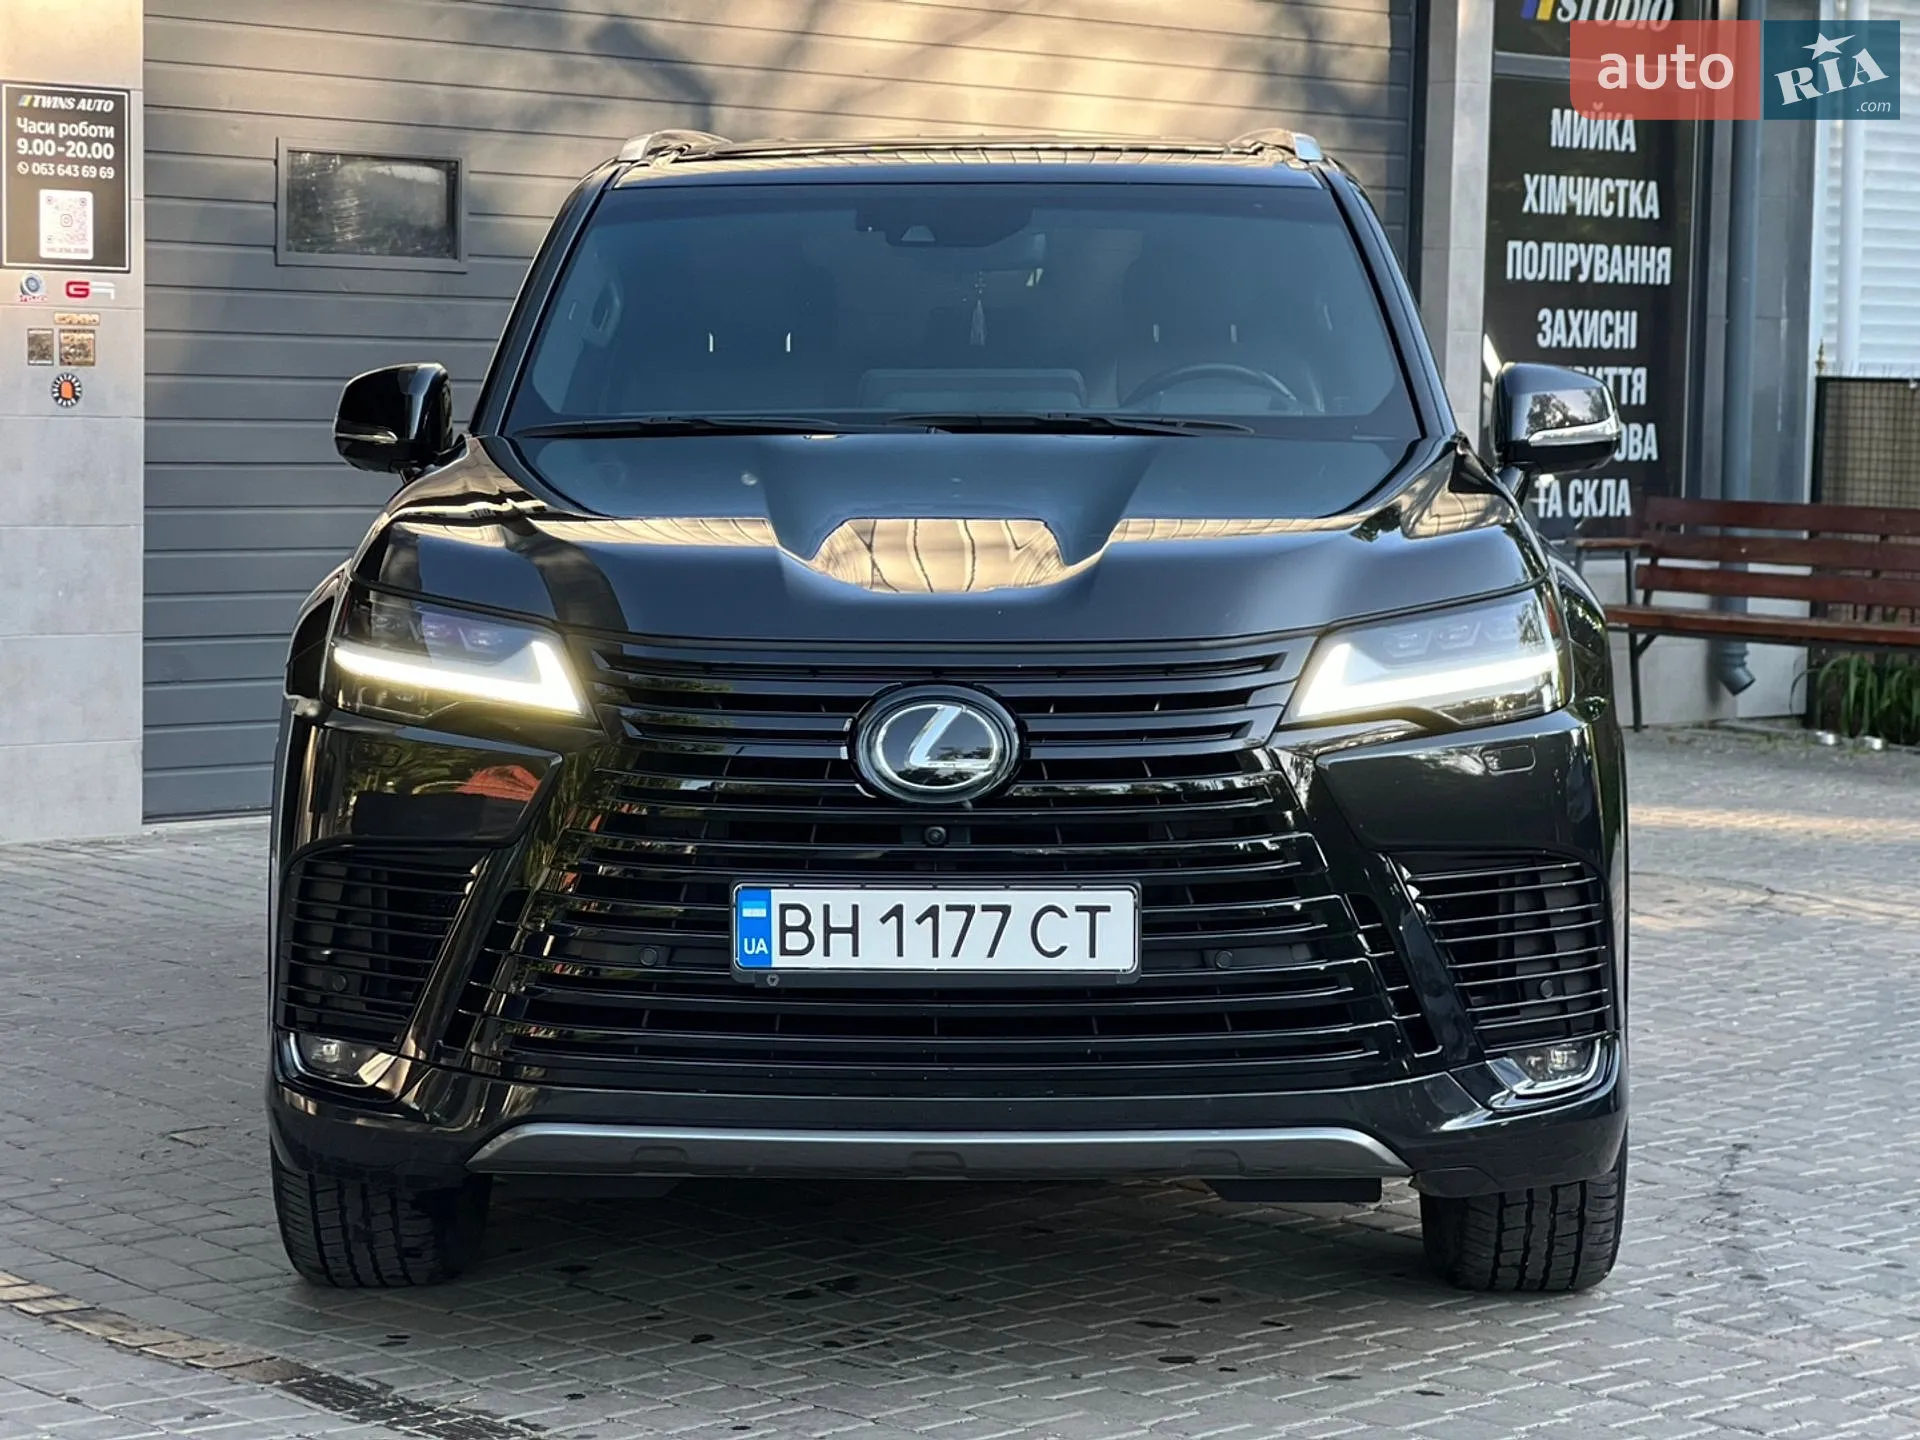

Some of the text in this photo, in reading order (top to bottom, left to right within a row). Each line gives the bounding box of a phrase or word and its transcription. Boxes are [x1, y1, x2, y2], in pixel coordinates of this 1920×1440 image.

[32, 94, 115, 113] TWINS AUTO
[16, 116, 115, 138] Часи роботи
[1550, 102, 1637, 152] МИЙКА
[16, 138, 115, 159] 9.00-20.00
[31, 162, 115, 179] 063 643 69 69
[1522, 173, 1661, 220] ХІМЧИСТКА
[1506, 240, 1672, 286] ПОЛІРУВАННЯ
[1537, 307, 1638, 349] ЗАХИСНІ
[1567, 478, 1632, 518] СКЛА
[743, 903, 1112, 958] UA BH 1177 CT
